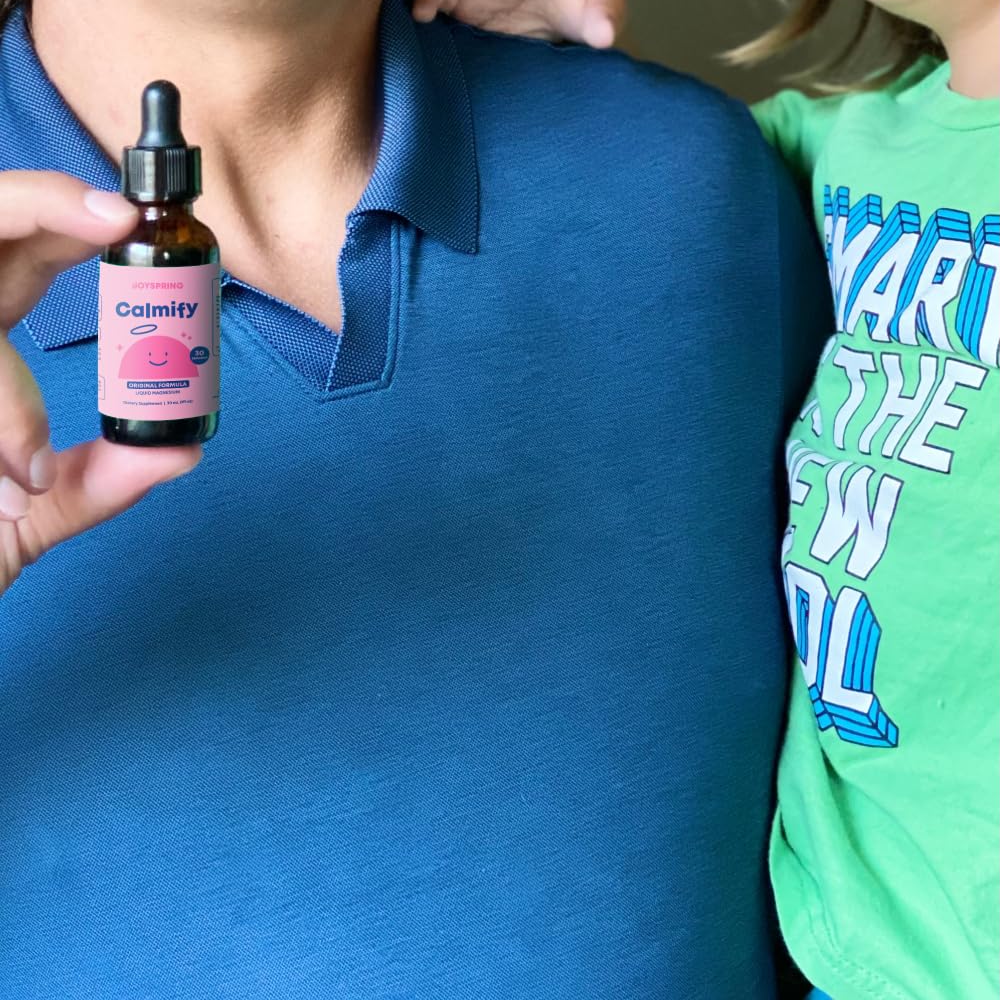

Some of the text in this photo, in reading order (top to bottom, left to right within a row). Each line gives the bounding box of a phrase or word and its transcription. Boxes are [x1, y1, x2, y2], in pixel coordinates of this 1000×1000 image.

[115, 301, 199, 319] Calmify
[132, 282, 184, 290] JOYSPRING
[823, 184, 1000, 368] MART
[833, 345, 990, 475] THE
[784, 440, 904, 581] EW
